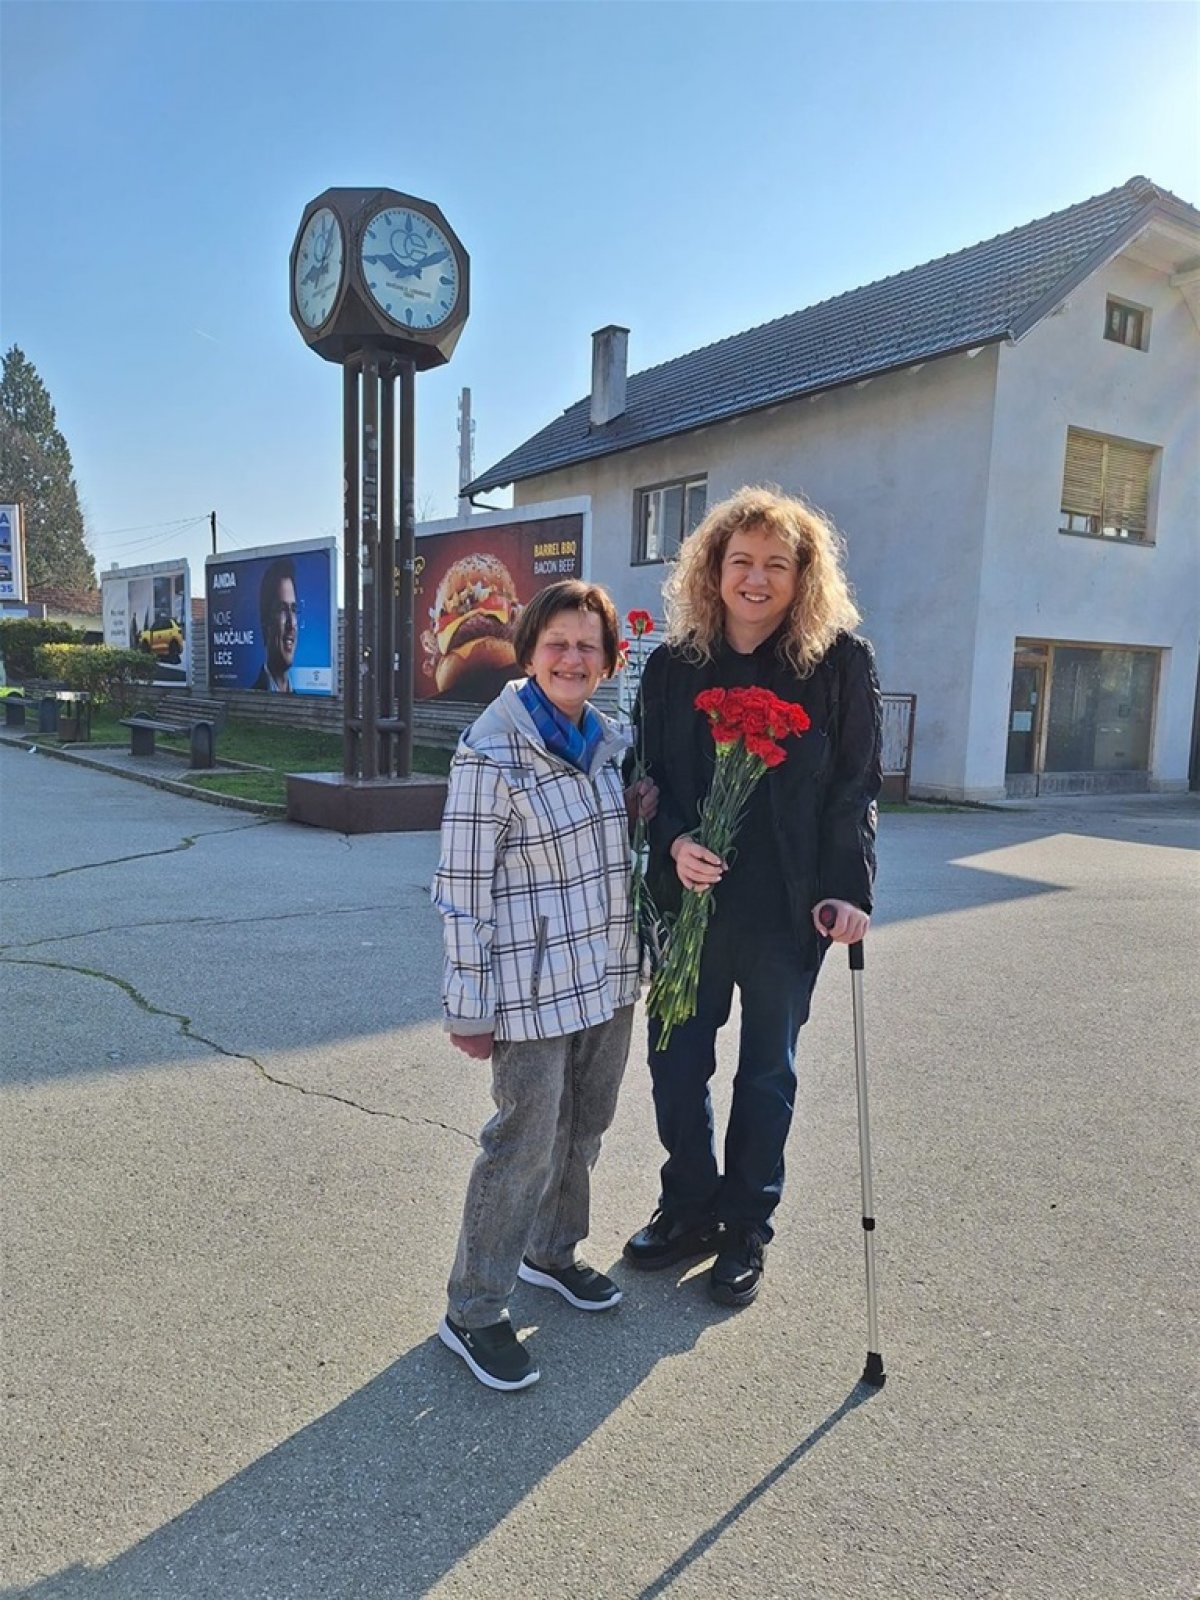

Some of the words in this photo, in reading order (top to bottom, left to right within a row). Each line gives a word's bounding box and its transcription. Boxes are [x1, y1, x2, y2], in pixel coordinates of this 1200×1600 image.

[534, 543, 559, 557] BARREL
[561, 540, 576, 556] BBQ
[534, 560, 557, 575] BACON
[559, 558, 576, 573] BEEF
[213, 611, 231, 626] NOVE
